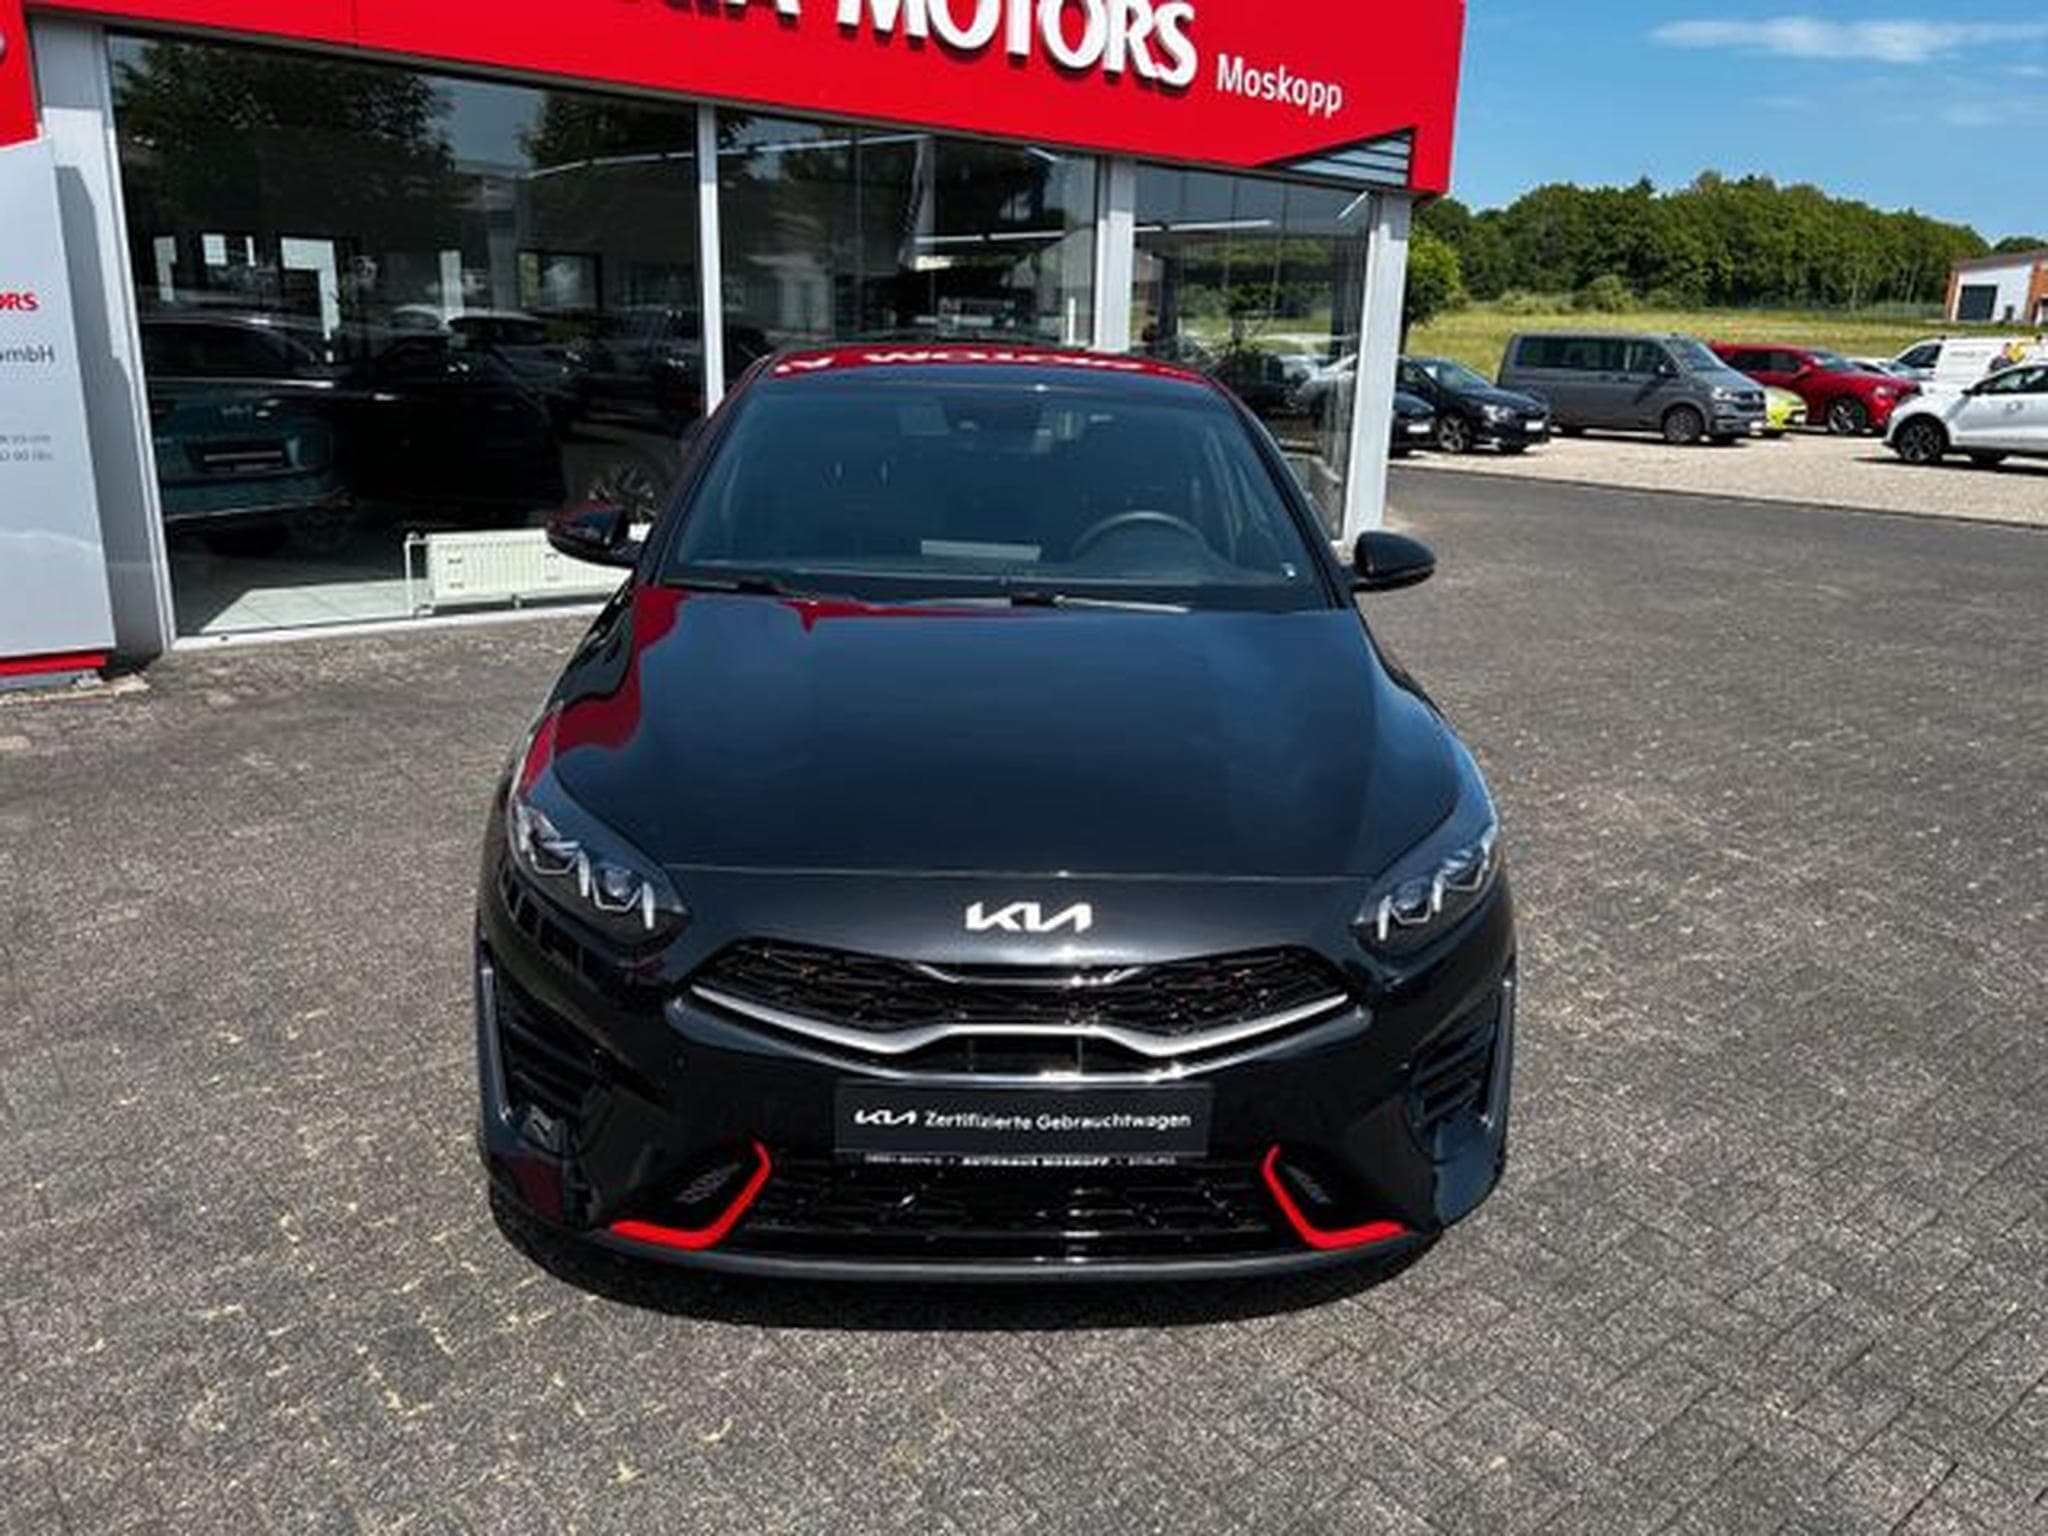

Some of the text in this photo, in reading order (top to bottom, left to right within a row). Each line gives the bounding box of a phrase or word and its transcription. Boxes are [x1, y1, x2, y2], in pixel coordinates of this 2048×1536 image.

[1217, 53, 1343, 118] Moskopp
[0, 345, 55, 363] mbH
[966, 901, 1092, 932] KIA
[854, 1110, 1193, 1131] KIA Zertifizierte Gebrauchtwagen
